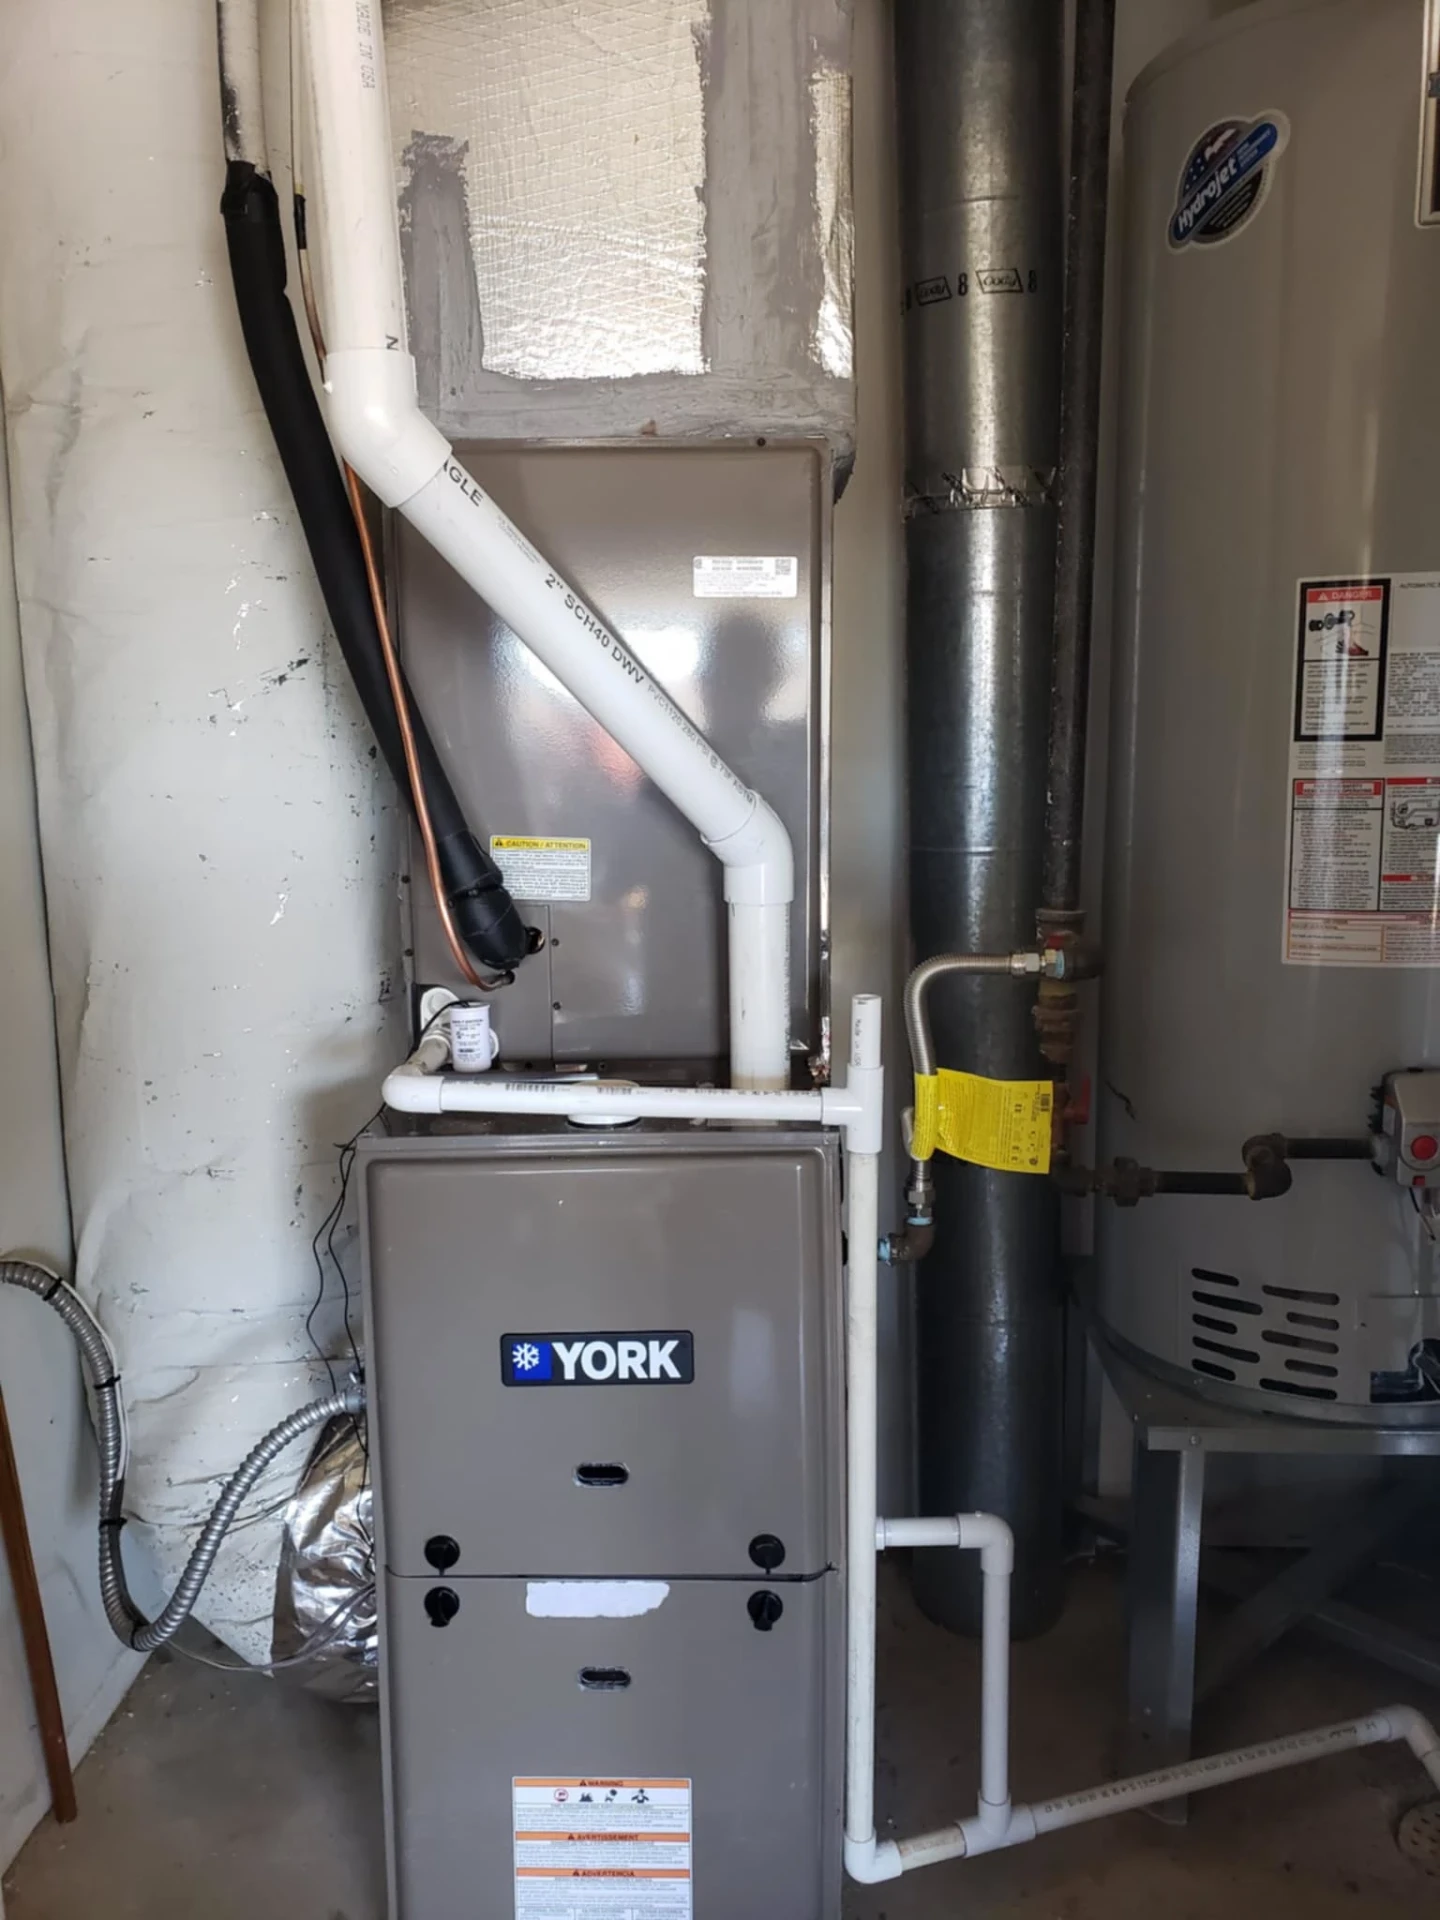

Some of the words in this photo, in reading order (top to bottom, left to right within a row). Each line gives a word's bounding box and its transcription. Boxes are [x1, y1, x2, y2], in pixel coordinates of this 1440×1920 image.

[1178, 157, 1238, 233] Hydrojet
[957, 272, 968, 297] 8
[563, 593, 611, 649] SCH40
[611, 646, 645, 684] DWV
[551, 1340, 682, 1381] YORK
